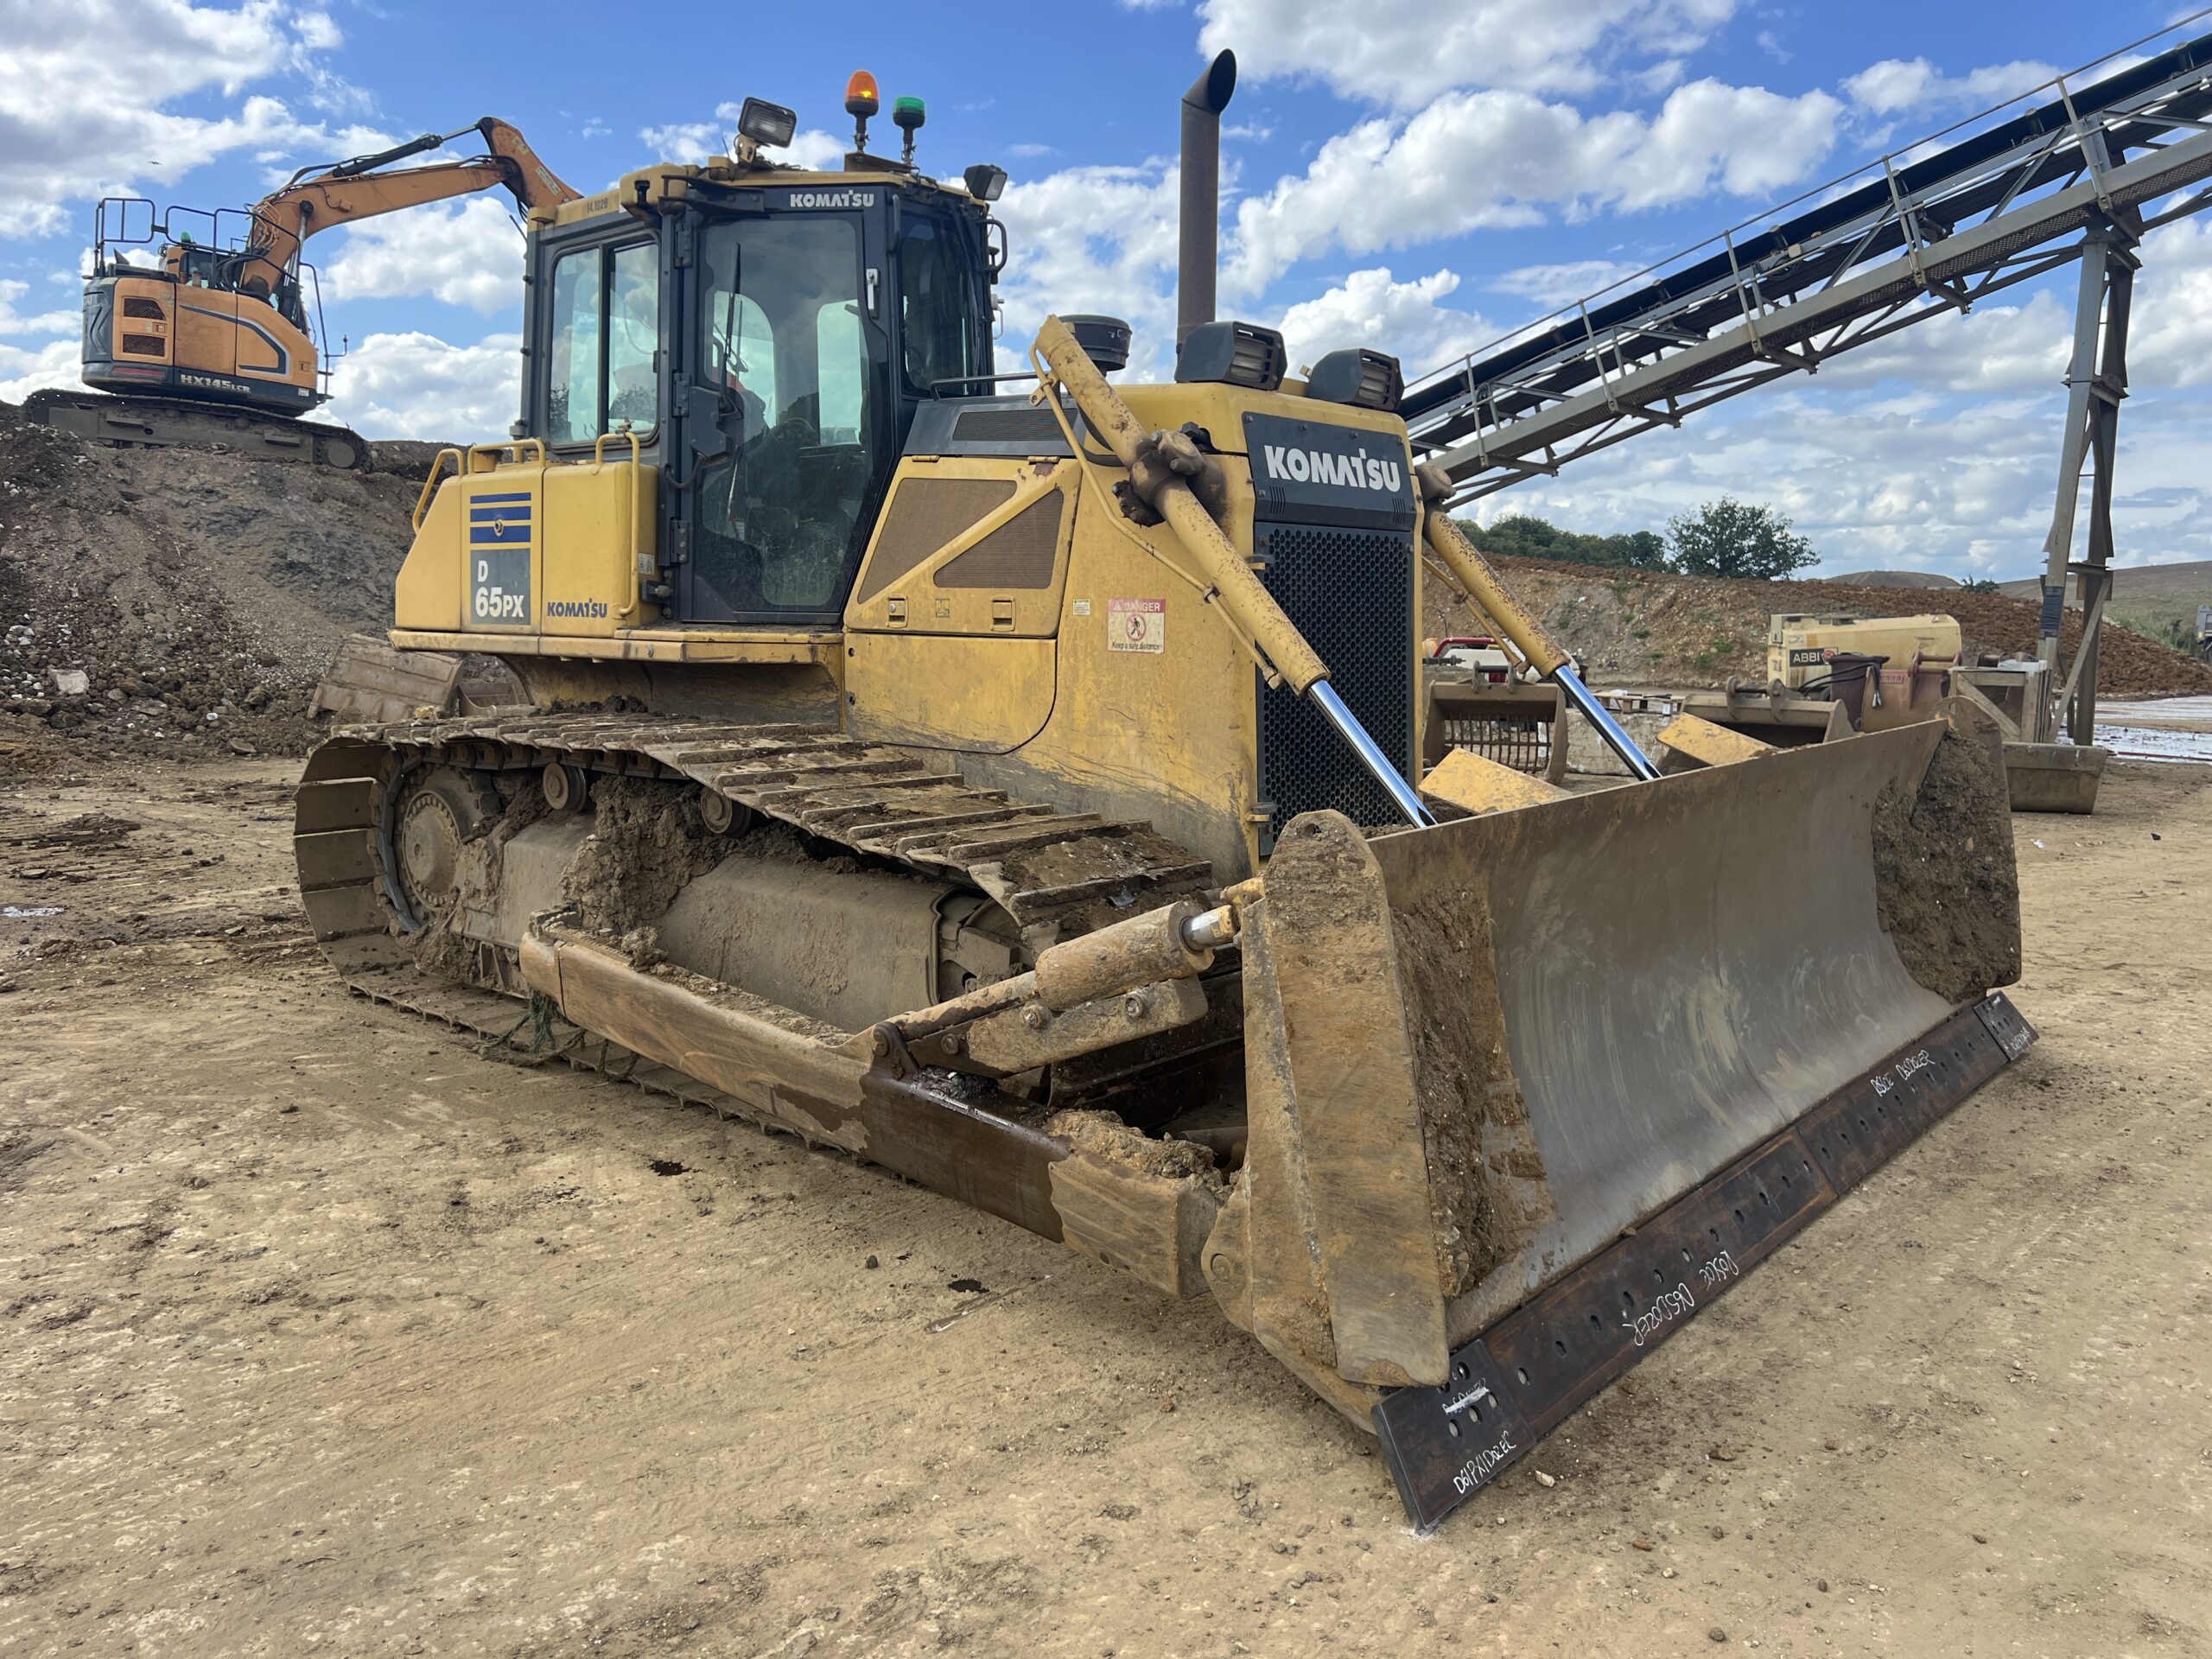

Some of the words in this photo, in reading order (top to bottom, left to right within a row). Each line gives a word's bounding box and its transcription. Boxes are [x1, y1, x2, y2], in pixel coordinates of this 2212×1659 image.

[790, 189, 874, 207] KOMATSU
[1264, 445, 1401, 493] KOMATSU
[477, 560, 489, 583] D
[475, 587, 524, 618] 65PX
[547, 598, 608, 618] KOMATSU
[1123, 601, 1161, 613] DANGER
[1112, 640, 1124, 650] Keep
